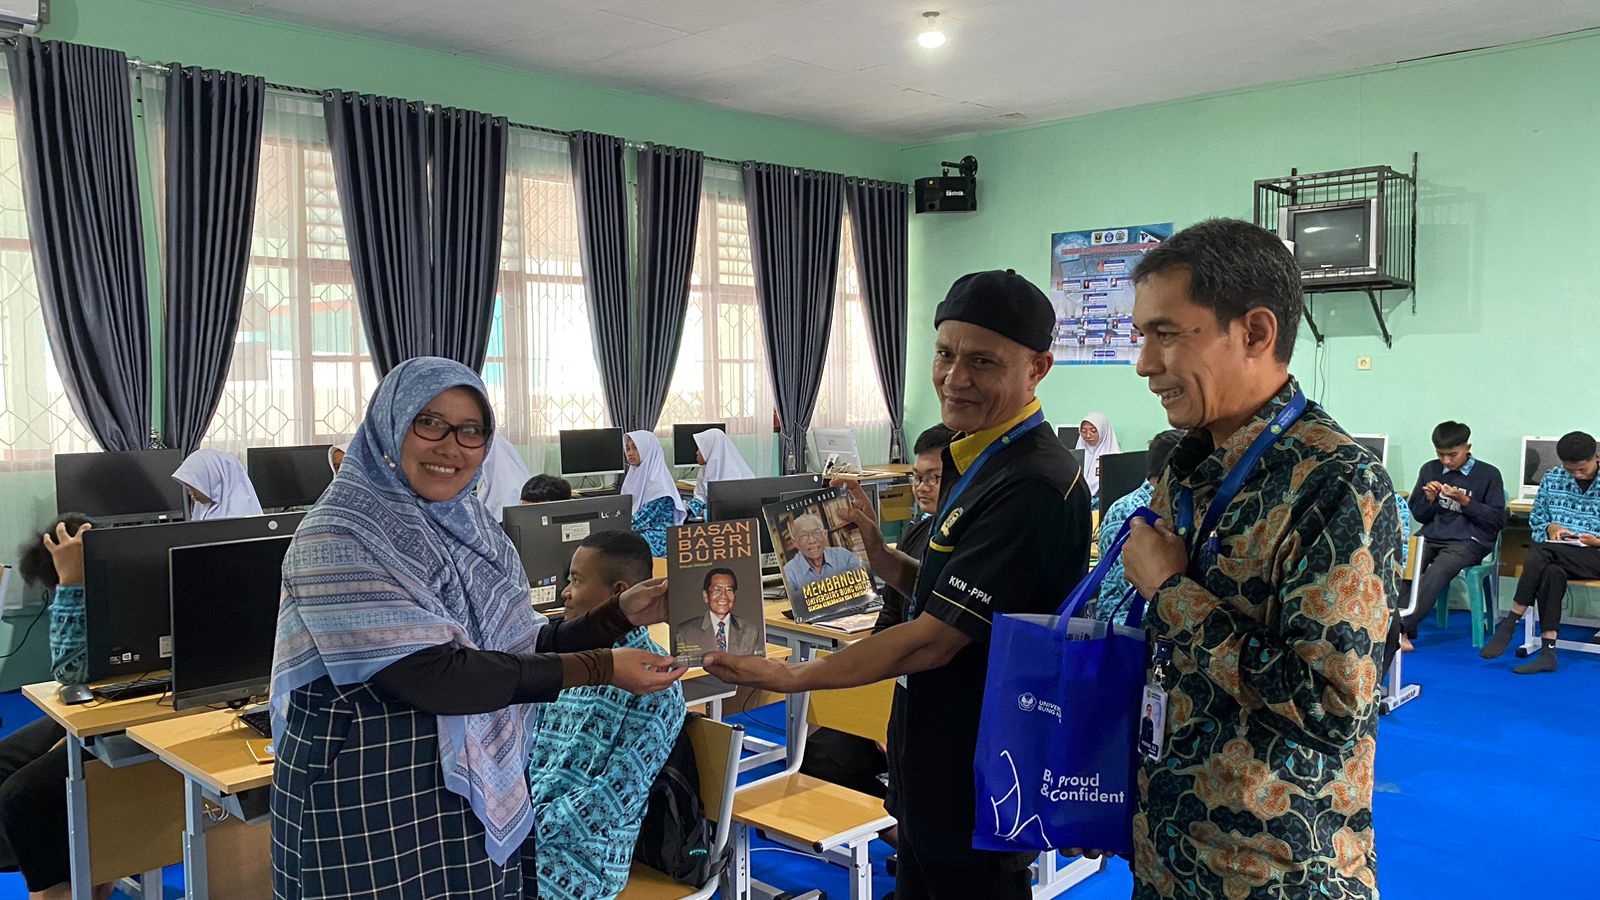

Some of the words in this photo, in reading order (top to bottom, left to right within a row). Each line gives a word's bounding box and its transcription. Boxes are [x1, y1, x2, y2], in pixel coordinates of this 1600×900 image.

[678, 521, 750, 539] HASAN
[678, 533, 751, 551] BASRI
[679, 545, 752, 564] DURIN
[802, 566, 870, 599] MEMBANGUN
[948, 575, 968, 592] KKN
